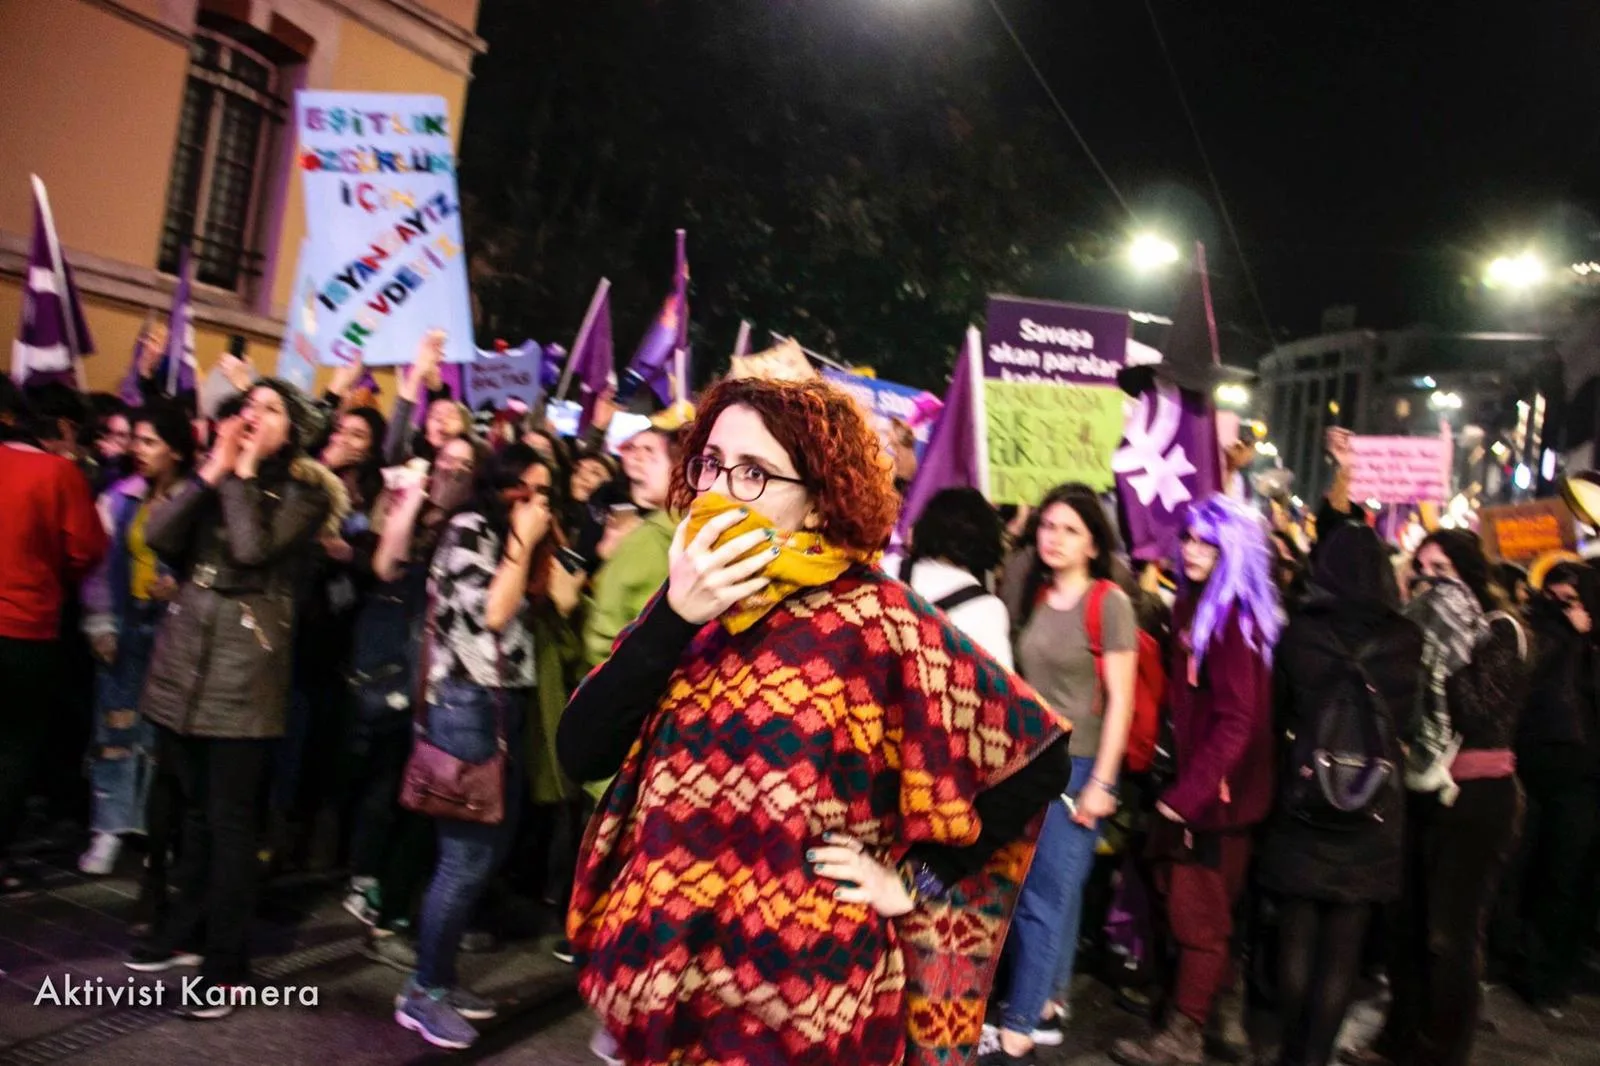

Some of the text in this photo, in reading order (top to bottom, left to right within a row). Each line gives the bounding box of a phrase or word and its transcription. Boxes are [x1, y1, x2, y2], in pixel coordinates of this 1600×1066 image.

[1019, 317, 1094, 352] Savaşa
[988, 341, 1041, 367] akan
[1042, 352, 1122, 378] paralar
